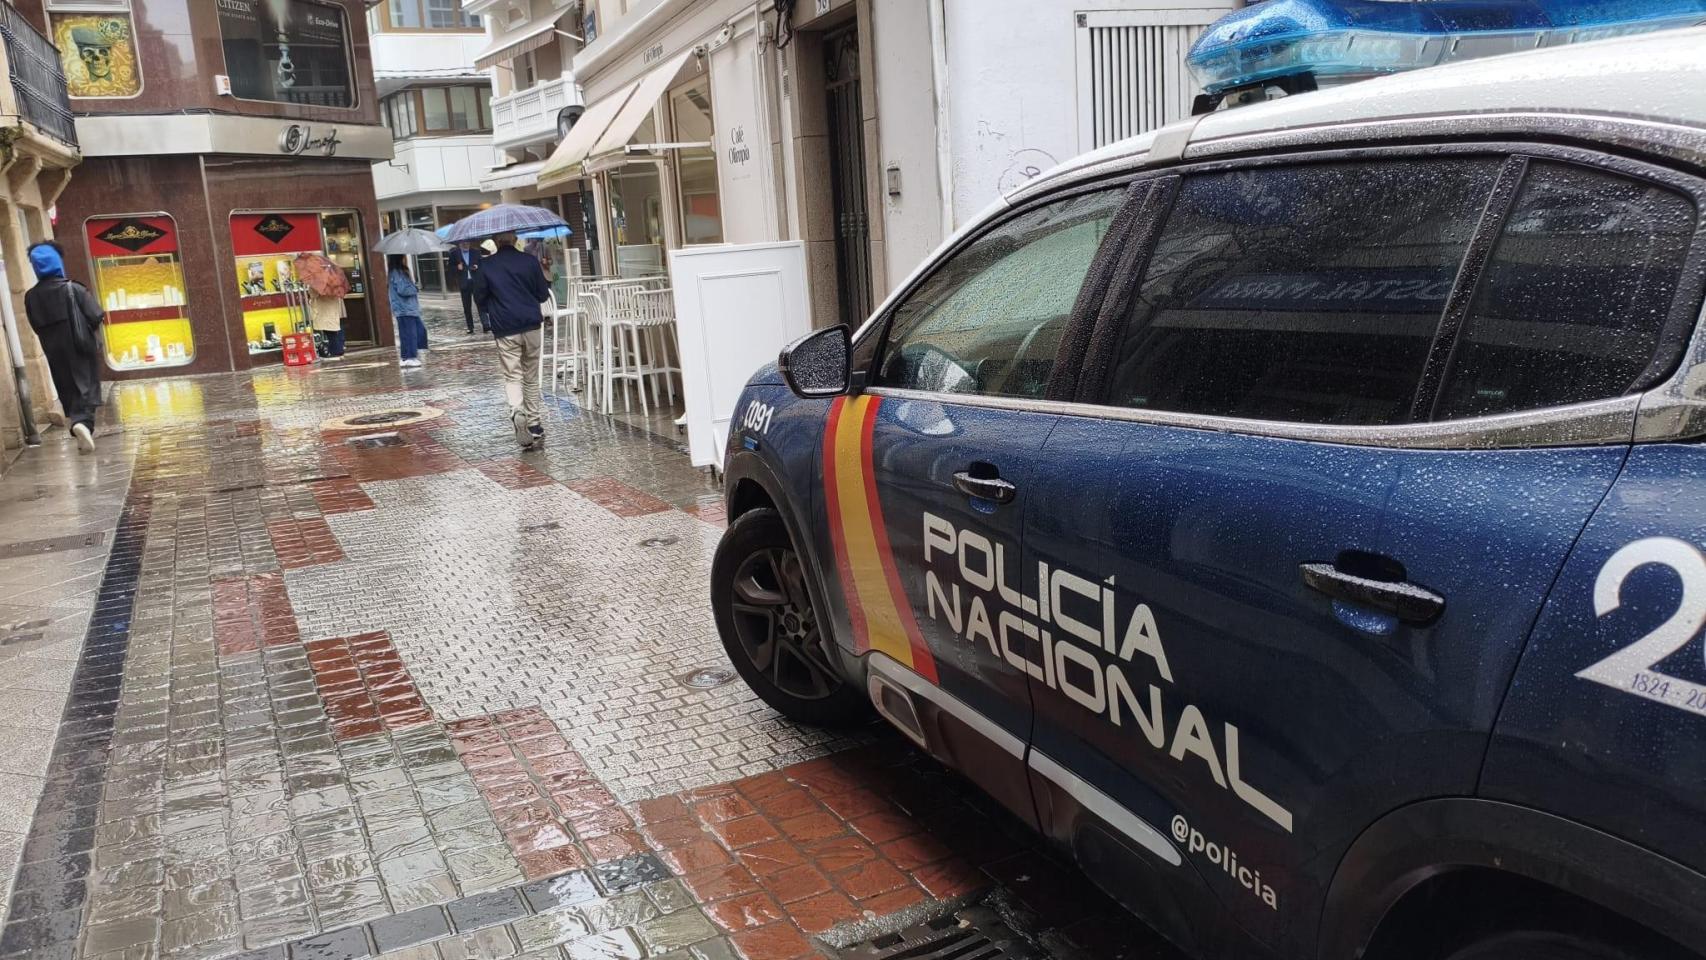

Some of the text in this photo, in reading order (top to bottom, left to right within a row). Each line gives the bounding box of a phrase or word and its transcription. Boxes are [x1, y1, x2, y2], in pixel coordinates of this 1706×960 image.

[217, 0, 251, 12] CITIZEN
[730, 124, 744, 145] Café
[728, 144, 750, 166] Olimpia
[923, 511, 1174, 684] POLICÍA
[1631, 672, 1670, 699] 1824
[926, 570, 1293, 834] NACIONAL
[1171, 814, 1278, 911] @policia
